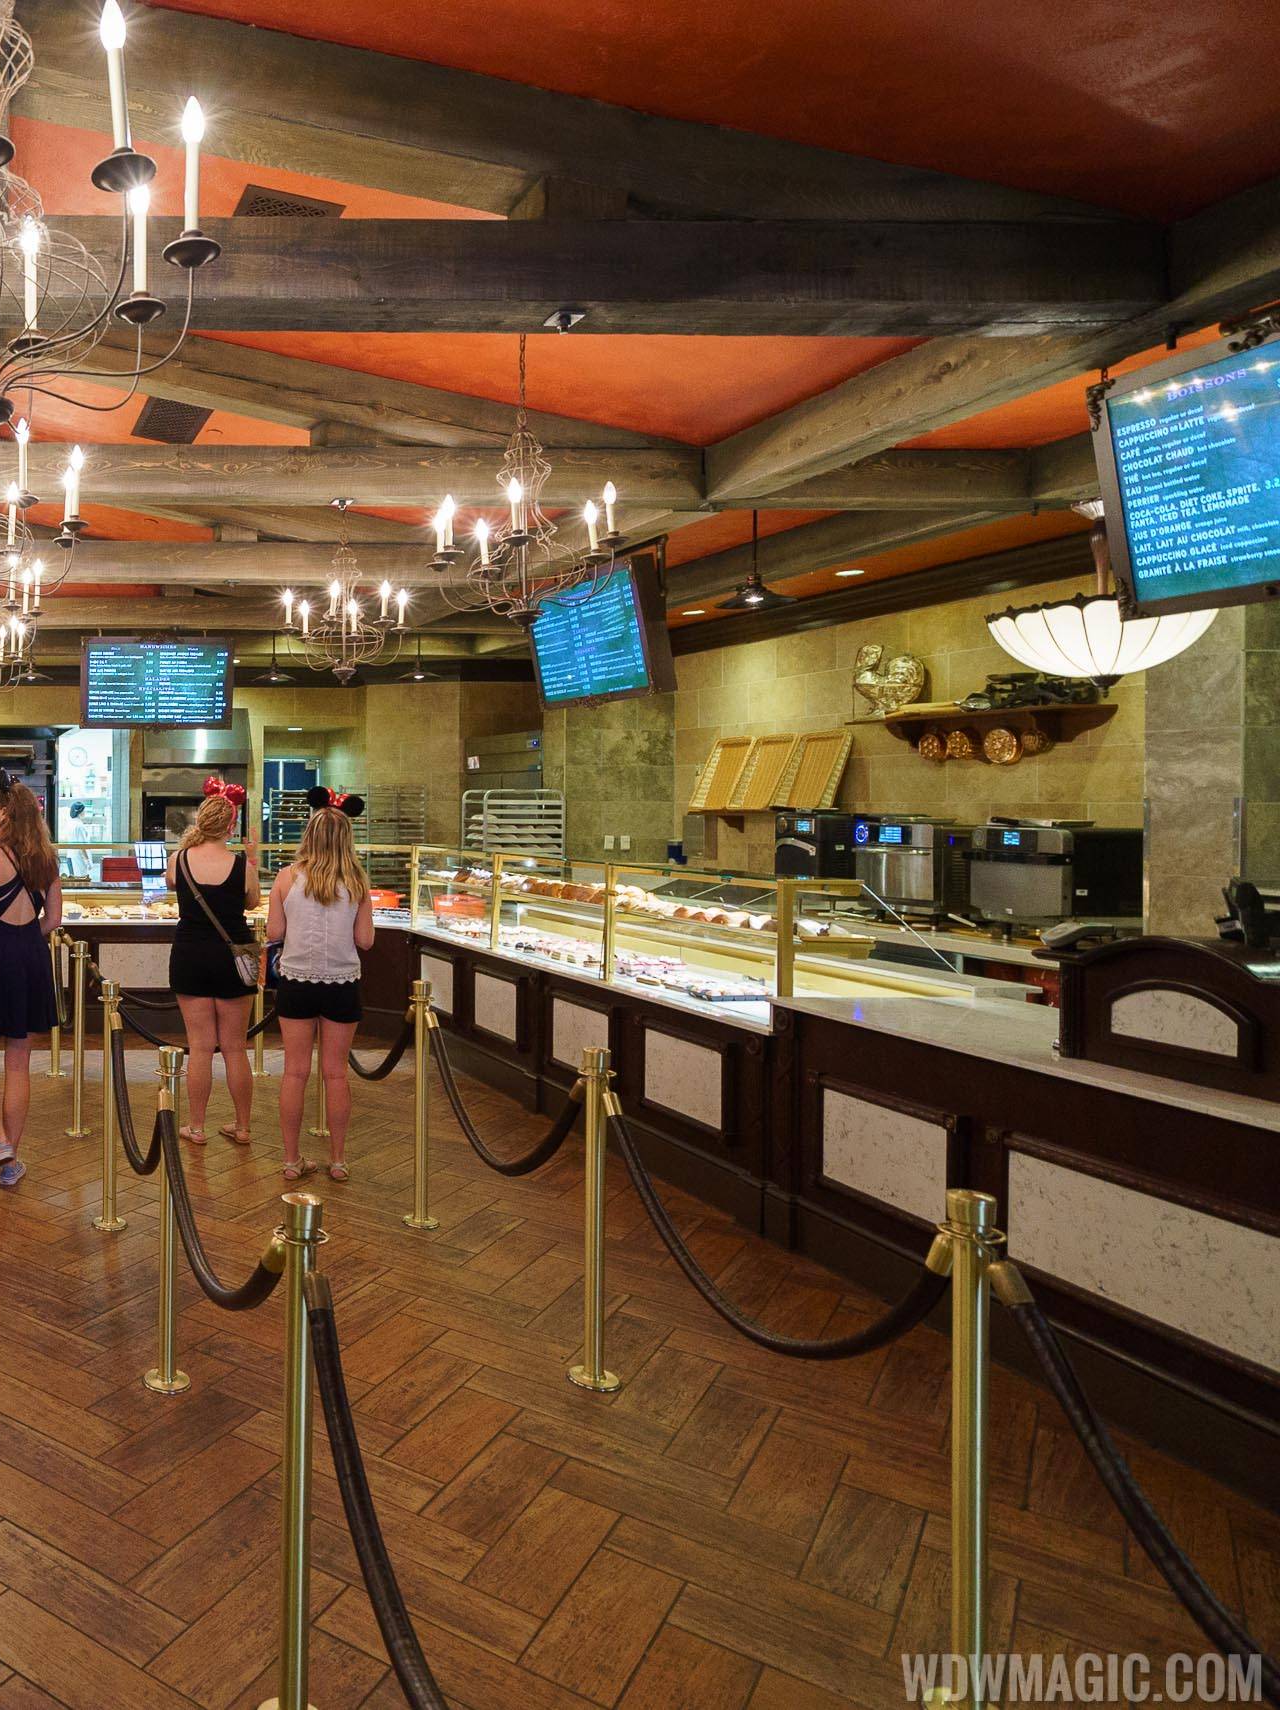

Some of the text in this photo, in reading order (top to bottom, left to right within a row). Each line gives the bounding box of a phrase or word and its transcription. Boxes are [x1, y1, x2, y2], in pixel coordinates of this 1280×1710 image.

[1167, 368, 1247, 401] BOISSONS
[1117, 418, 1156, 437] ESPRESSO
[1118, 427, 1169, 449] CAPPUCCINO
[1178, 415, 1204, 431] LATTE
[1120, 447, 1140, 460] CAFÉ
[1122, 454, 1163, 473] CHOCOLAT
[1165, 446, 1194, 460] CHAUD
[1124, 473, 1139, 485] THÉ
[1126, 486, 1141, 497] EAU
[1127, 494, 1159, 509] PERRIER
[1160, 511, 1178, 522] ICED
[1202, 494, 1250, 513] LEMONADE
[1180, 497, 1198, 509] DIET
[1133, 530, 1148, 541] JUS
[1150, 521, 1192, 537] D'ORANGE
[1156, 538, 1174, 549] LAIT
[1176, 535, 1188, 545] AU
[1190, 525, 1236, 542] CHOCOLAT
[1136, 550, 1187, 566] CAPPUCCINO
[1189, 542, 1217, 556] GLACÉ
[1138, 564, 1172, 579] GRANITÉ
[1183, 561, 1195, 571] LA
[1197, 555, 1227, 569] FRAISE
